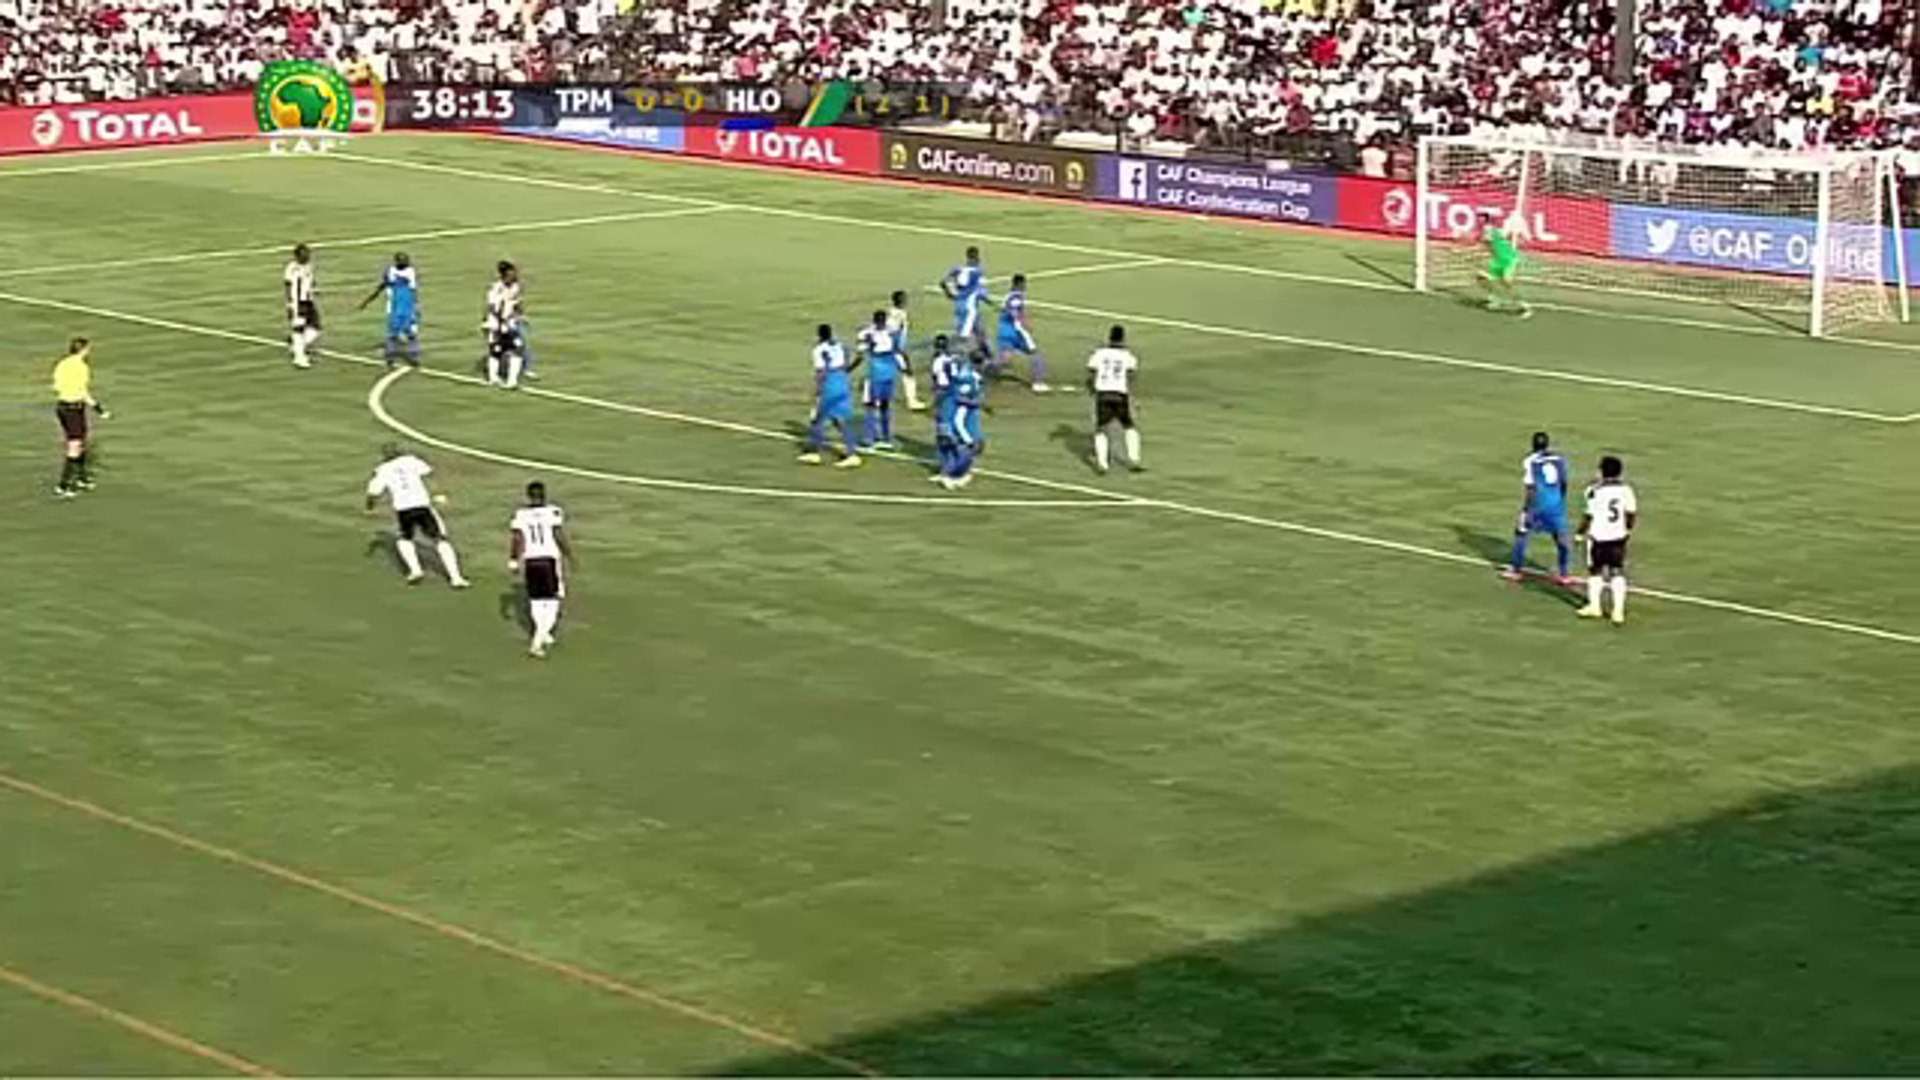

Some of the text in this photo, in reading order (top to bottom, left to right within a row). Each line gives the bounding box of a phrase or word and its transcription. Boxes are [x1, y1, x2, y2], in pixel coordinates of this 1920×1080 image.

[917, 146, 1056, 185] CAFonline.com
[1157, 164, 1312, 196] CAF Champions League
[1157, 188, 1311, 219] CAF Confederation Cup
[1688, 224, 1879, 274] @CAF Oline
[1607, 498, 1620, 523] 5
[528, 521, 545, 546] 11
